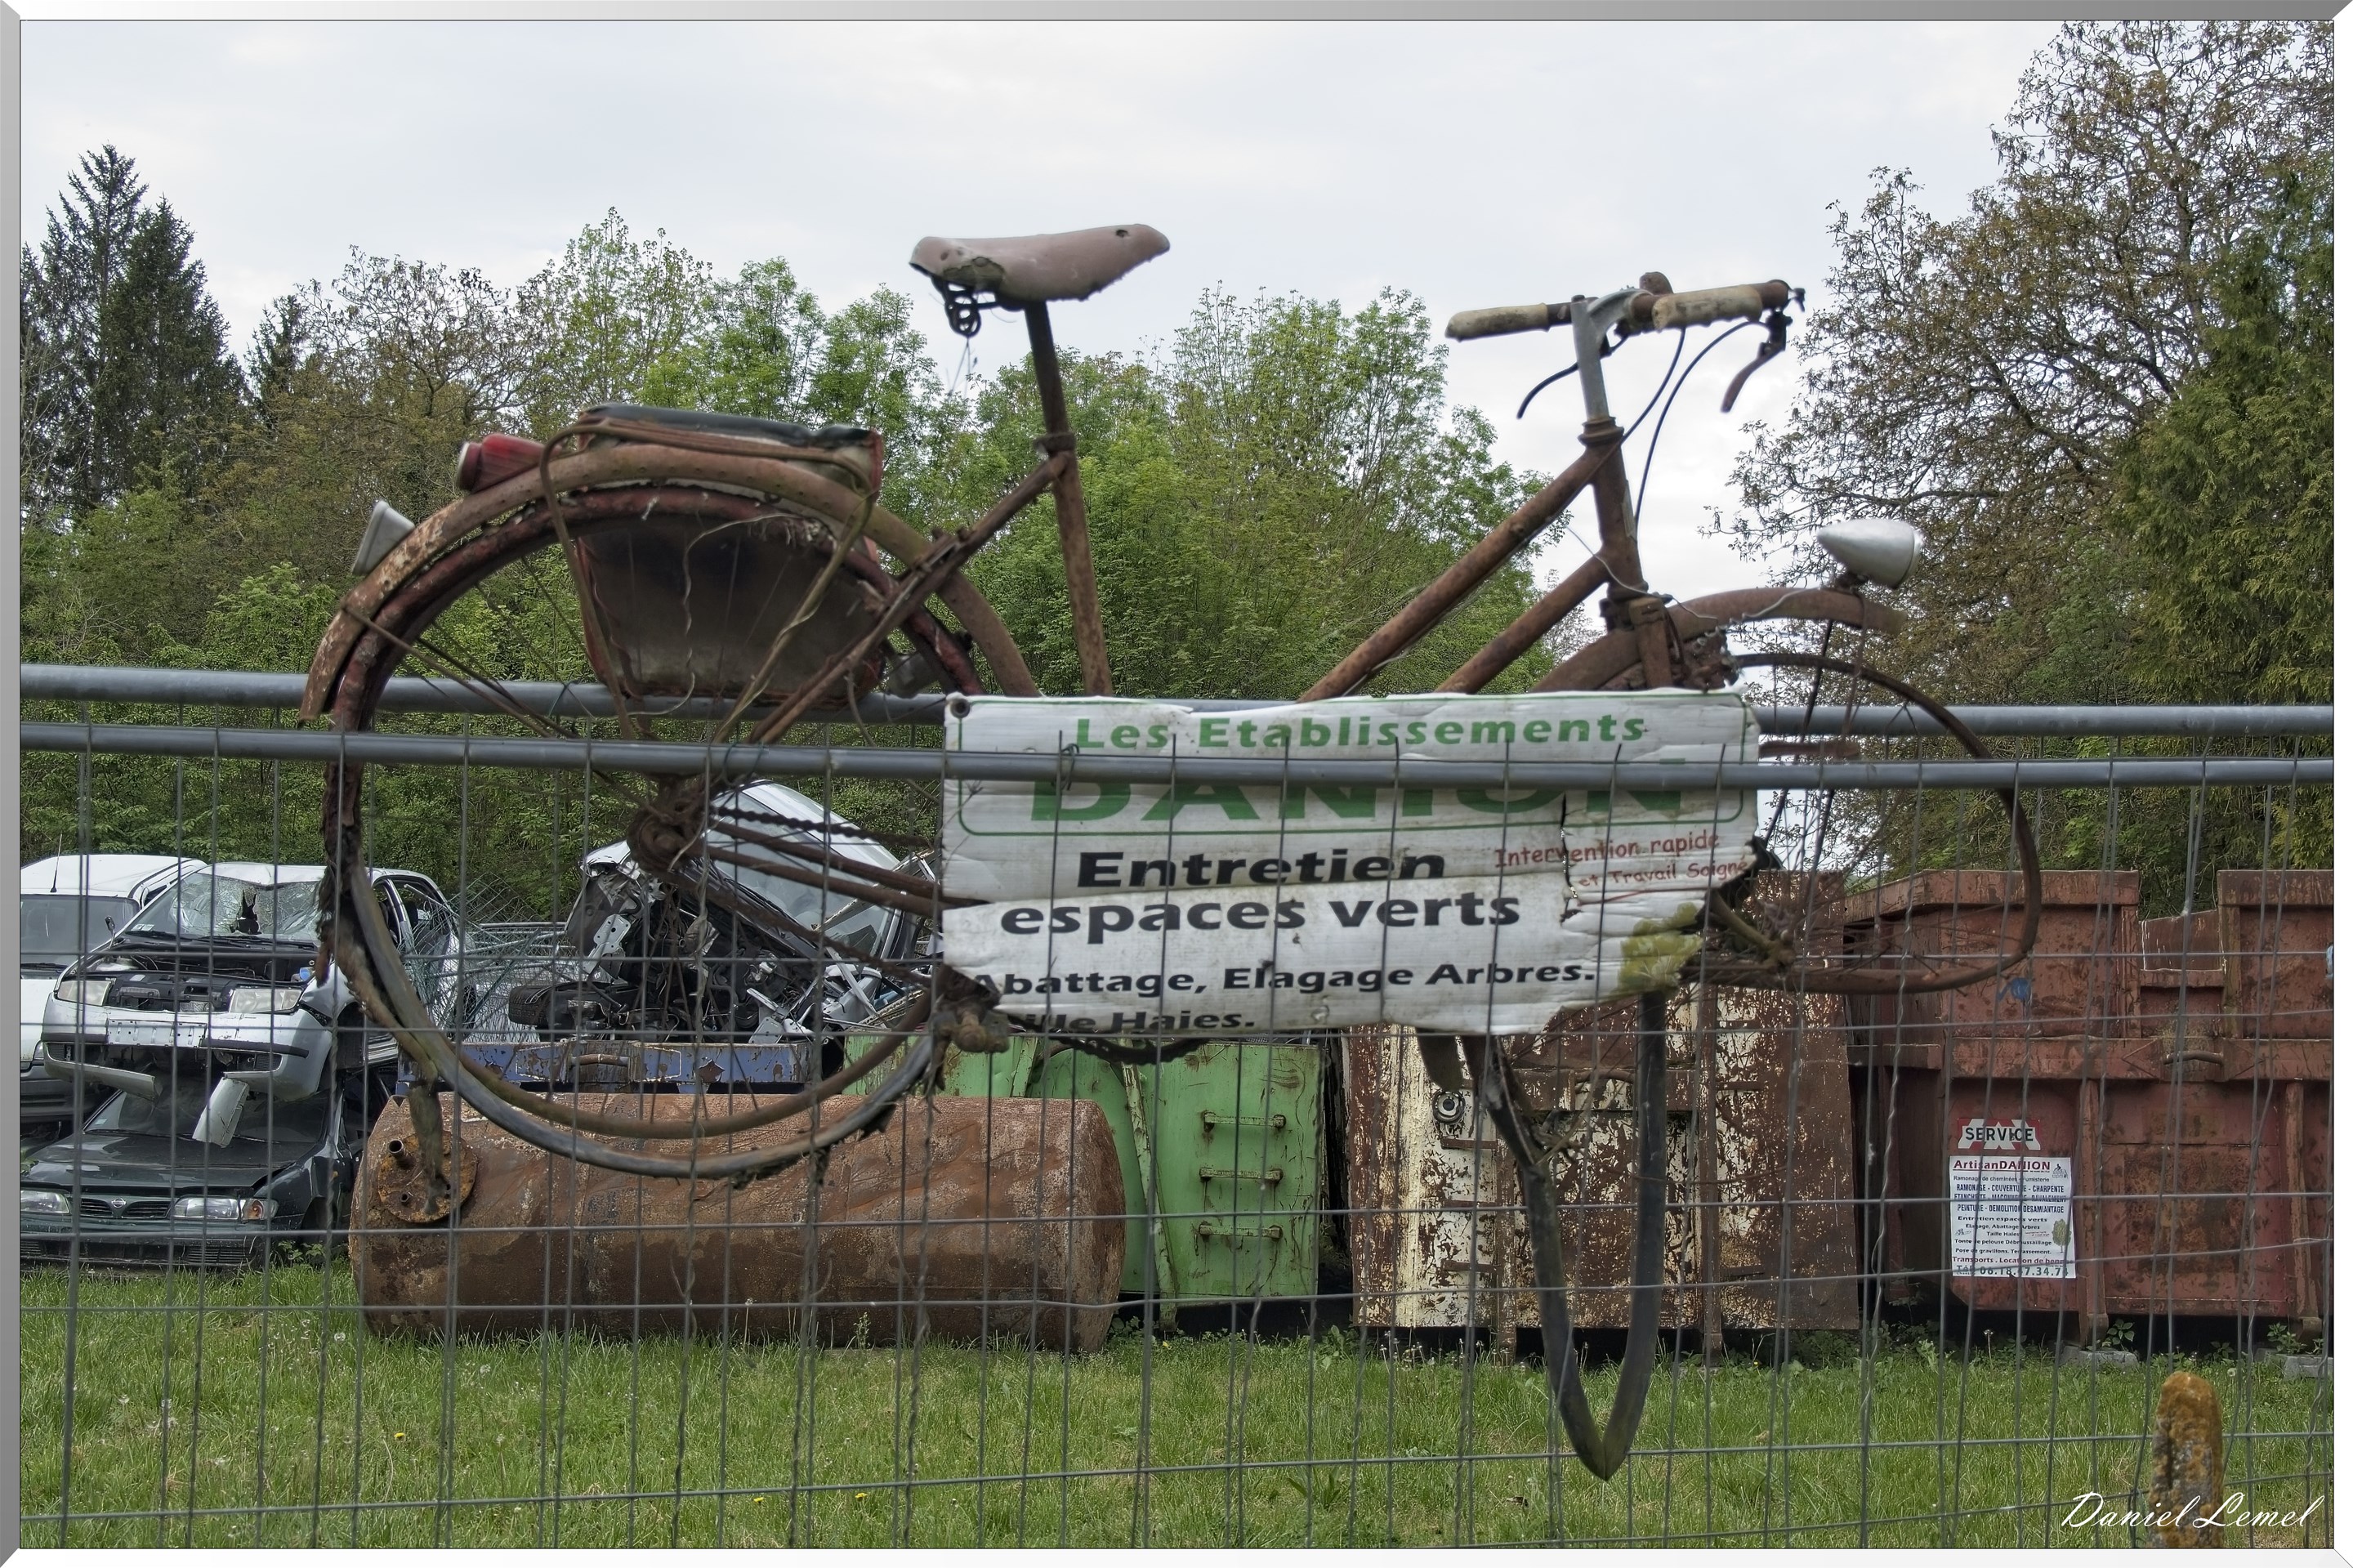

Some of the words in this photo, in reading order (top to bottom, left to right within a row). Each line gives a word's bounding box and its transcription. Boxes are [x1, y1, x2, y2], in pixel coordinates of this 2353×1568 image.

[1077, 718, 1169, 749] Les
[1199, 714, 1645, 748] Etablissements
[1494, 839, 1638, 868] Intervention
[1650, 829, 1720, 857] rapide
[1078, 849, 1445, 888] Entretien
[1578, 873, 1598, 887] et
[1611, 861, 1677, 884] Travail
[1001, 901, 1306, 945] espaces
[1329, 892, 1520, 928] verts
[1223, 966, 1413, 996] Elagage
[1426, 963, 1595, 985] Arbres.
[1111, 1011, 1255, 1032] Haies.
[1965, 1128, 2034, 1141] SERVICE
[1991, 1184, 2027, 1192] COUVERTUE
[2032, 1185, 2065, 1193] CHARPENTE
